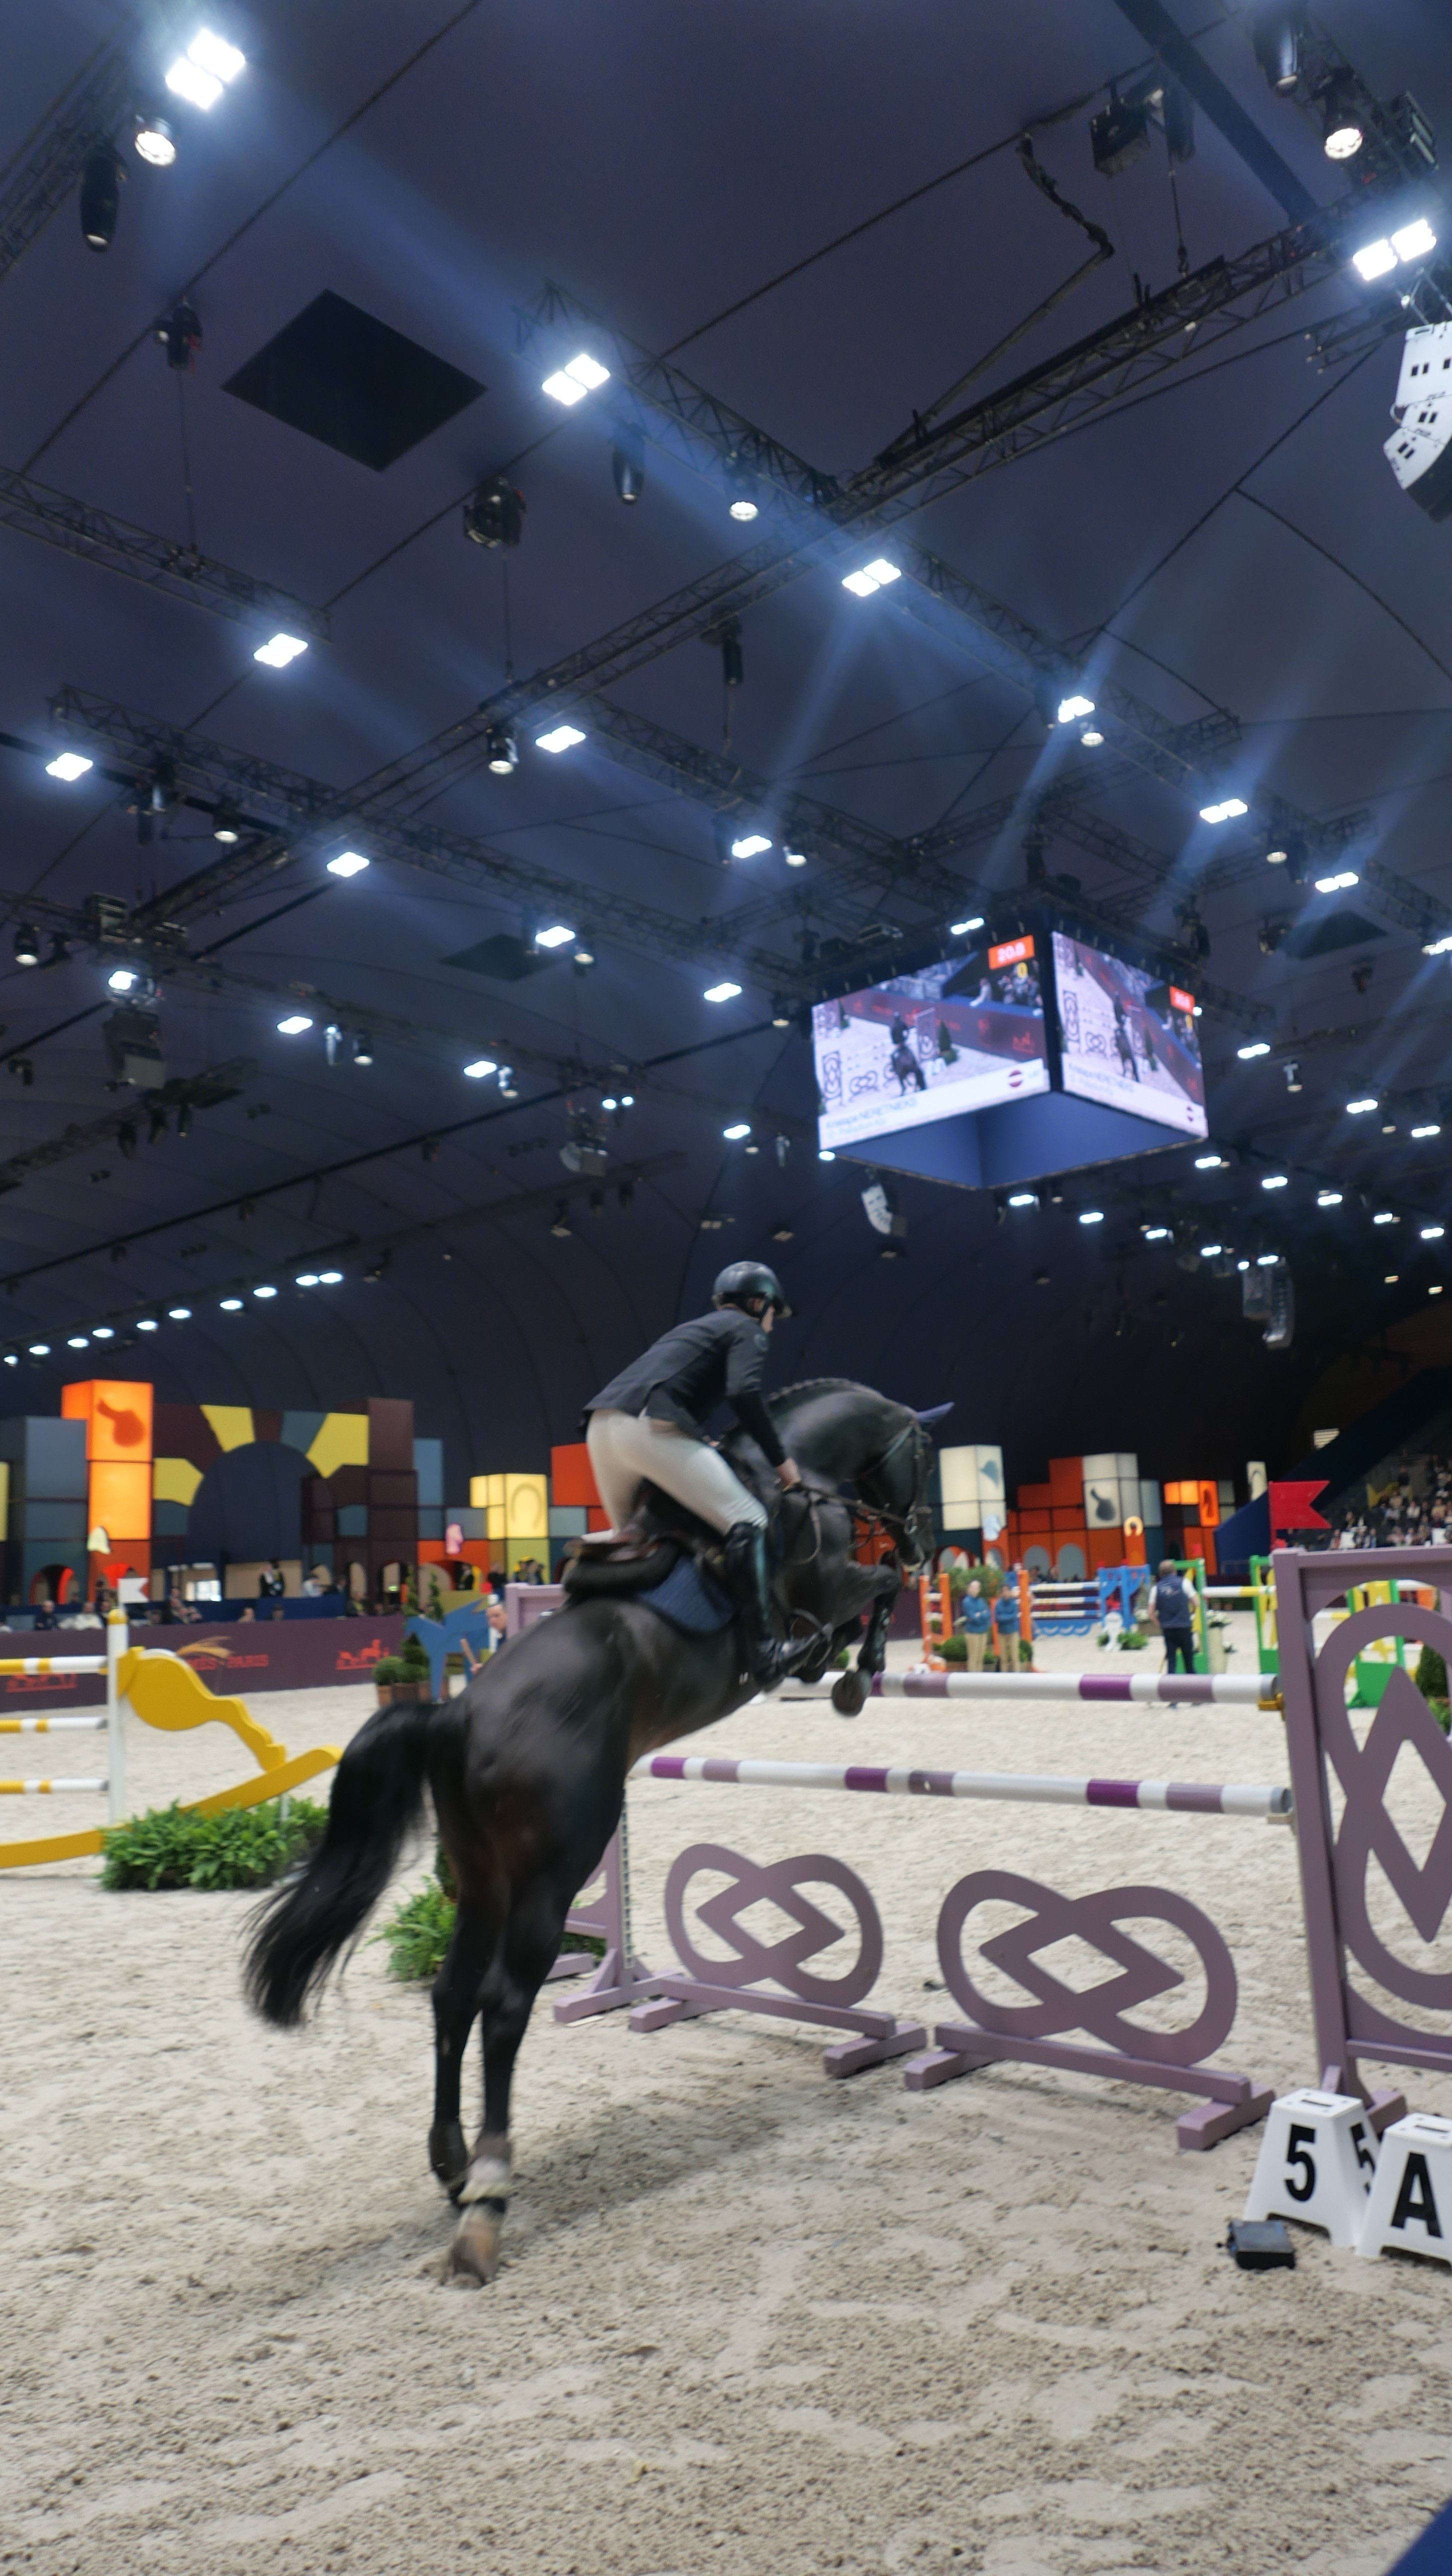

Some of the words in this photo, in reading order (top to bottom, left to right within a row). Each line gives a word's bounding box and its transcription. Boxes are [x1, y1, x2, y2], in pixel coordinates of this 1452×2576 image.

[1284, 2124, 1316, 2202] 5
[1350, 2122, 1376, 2196] 5
[1390, 2152, 1444, 2239] A
